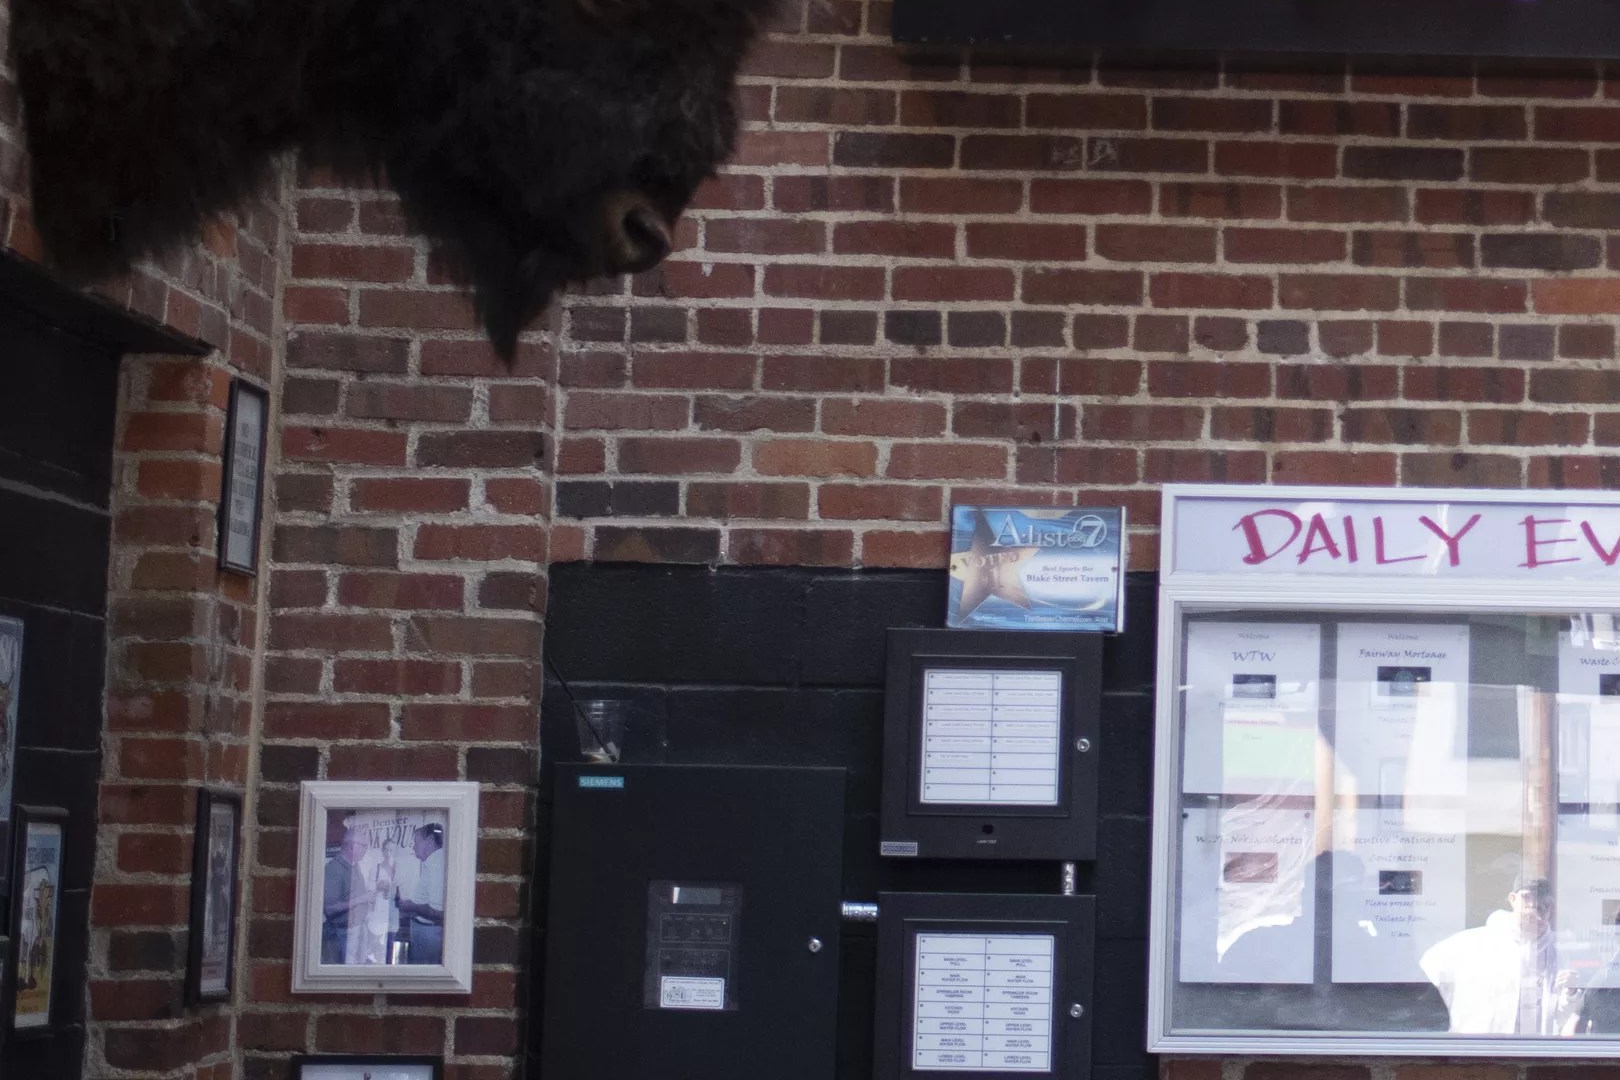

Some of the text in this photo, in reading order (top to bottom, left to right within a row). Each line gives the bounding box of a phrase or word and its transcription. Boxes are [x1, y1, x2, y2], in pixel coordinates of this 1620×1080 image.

[1232, 508, 1482, 568] DAILY
[1026, 574, 1110, 583] Blake Street Tavern
[1359, 649, 1448, 663] Fairway Mortgage
[580, 778, 622, 787] SIEMENS
